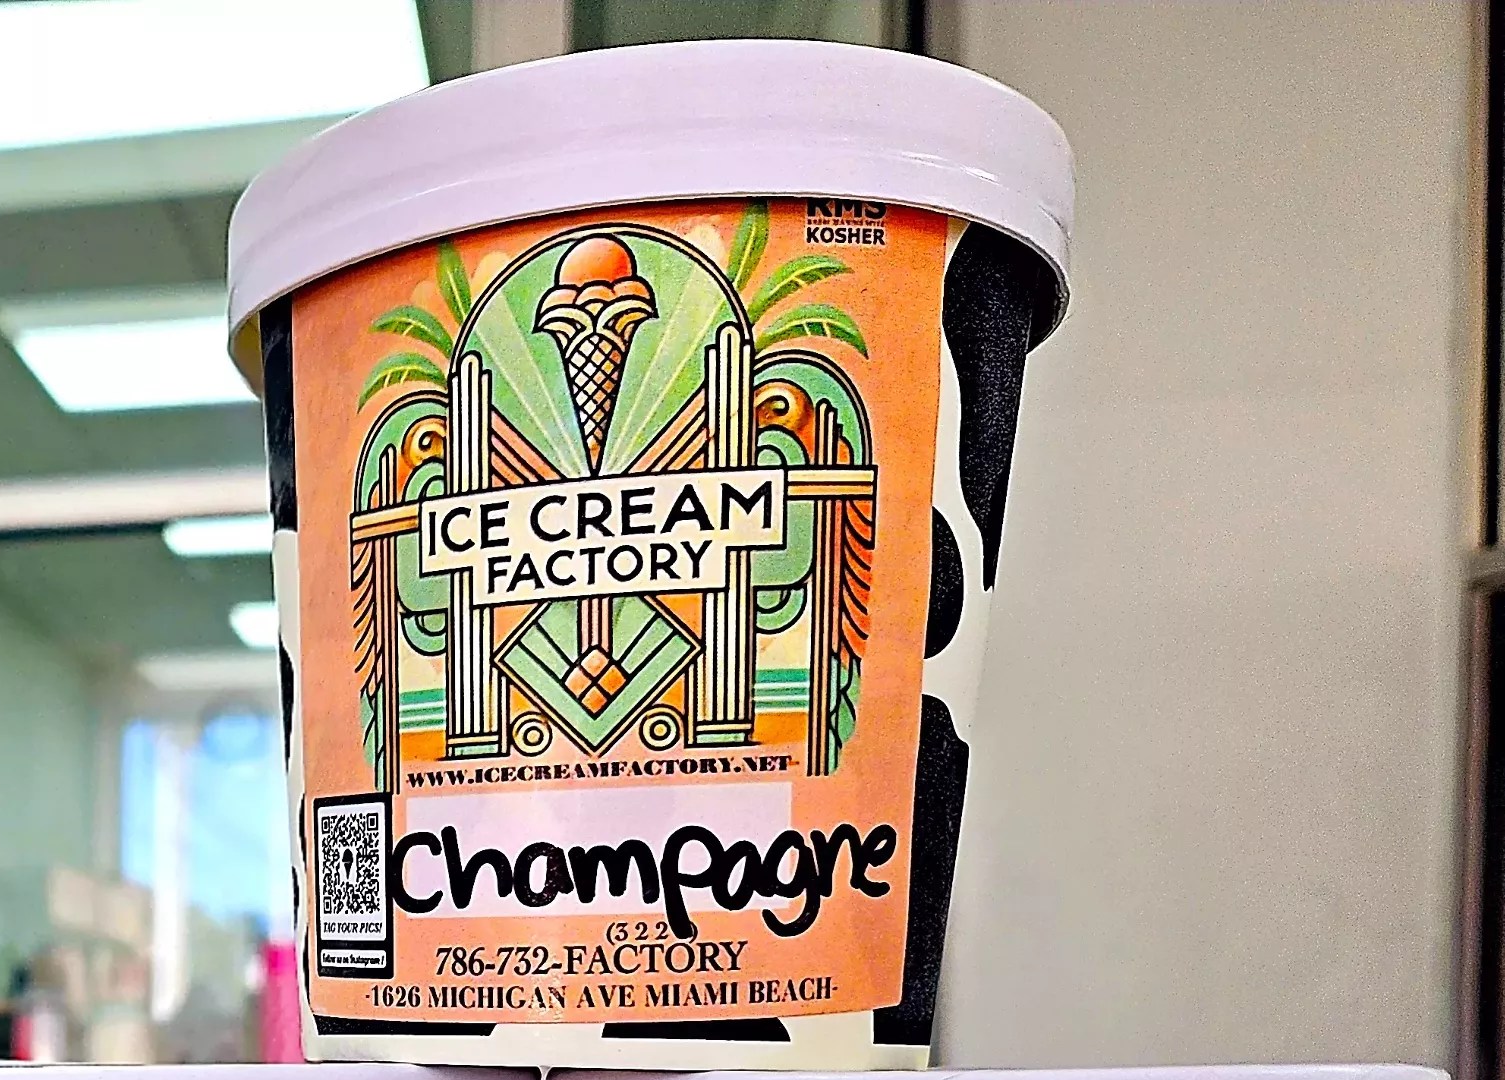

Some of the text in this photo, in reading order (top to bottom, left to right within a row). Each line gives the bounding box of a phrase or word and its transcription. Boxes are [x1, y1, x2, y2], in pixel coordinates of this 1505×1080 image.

[806, 227, 885, 245] KOSHER
[428, 481, 772, 556] ICE CREAM
[487, 540, 712, 595] FACTORY
[337, 922, 358, 933] YOUR
[359, 922, 382, 933] PICS!
[436, 941, 748, 977] 786-732-FACTORY
[428, 985, 565, 1009] MICHIGAN
[577, 984, 635, 1008] AVE
[645, 981, 738, 1008] MIAMI
